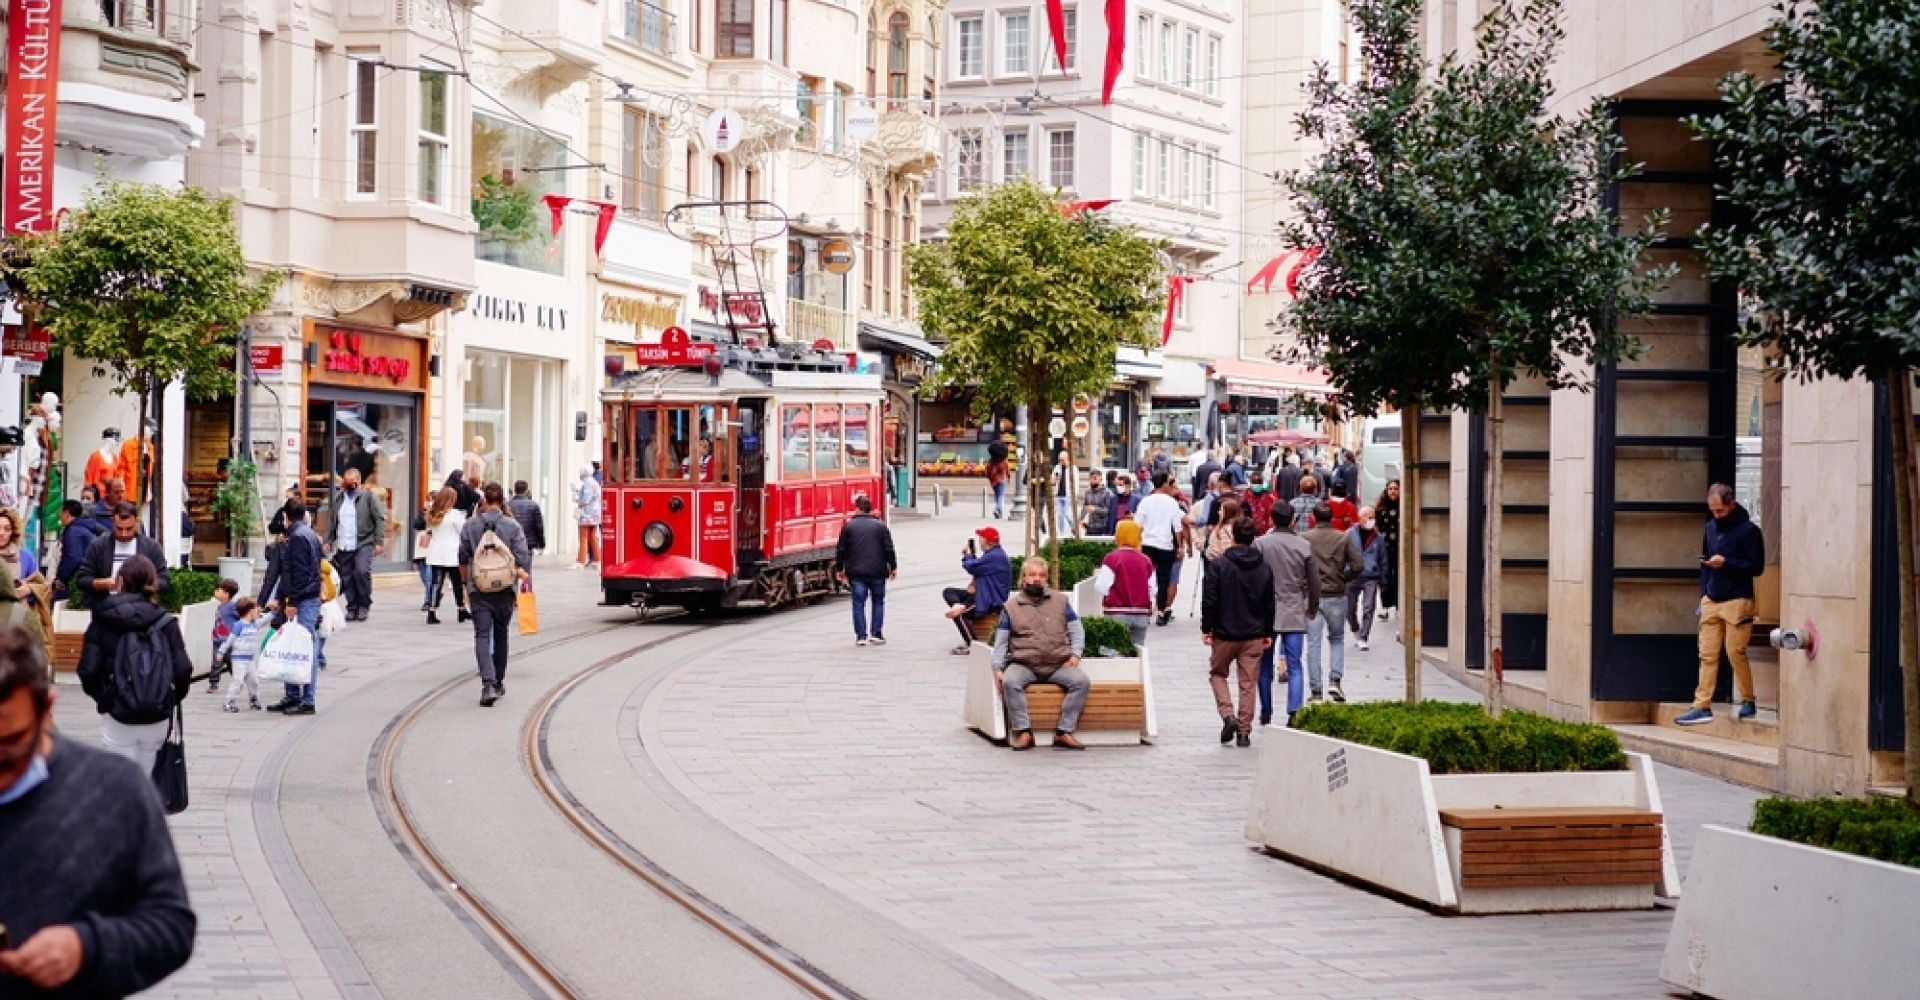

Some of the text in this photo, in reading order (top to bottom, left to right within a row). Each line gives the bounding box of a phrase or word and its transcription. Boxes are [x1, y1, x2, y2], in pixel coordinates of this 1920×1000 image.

[15, 93, 46, 236] AMERİKAN
[671, 328, 679, 343] 2
[638, 345, 669, 360] TAKSİM
